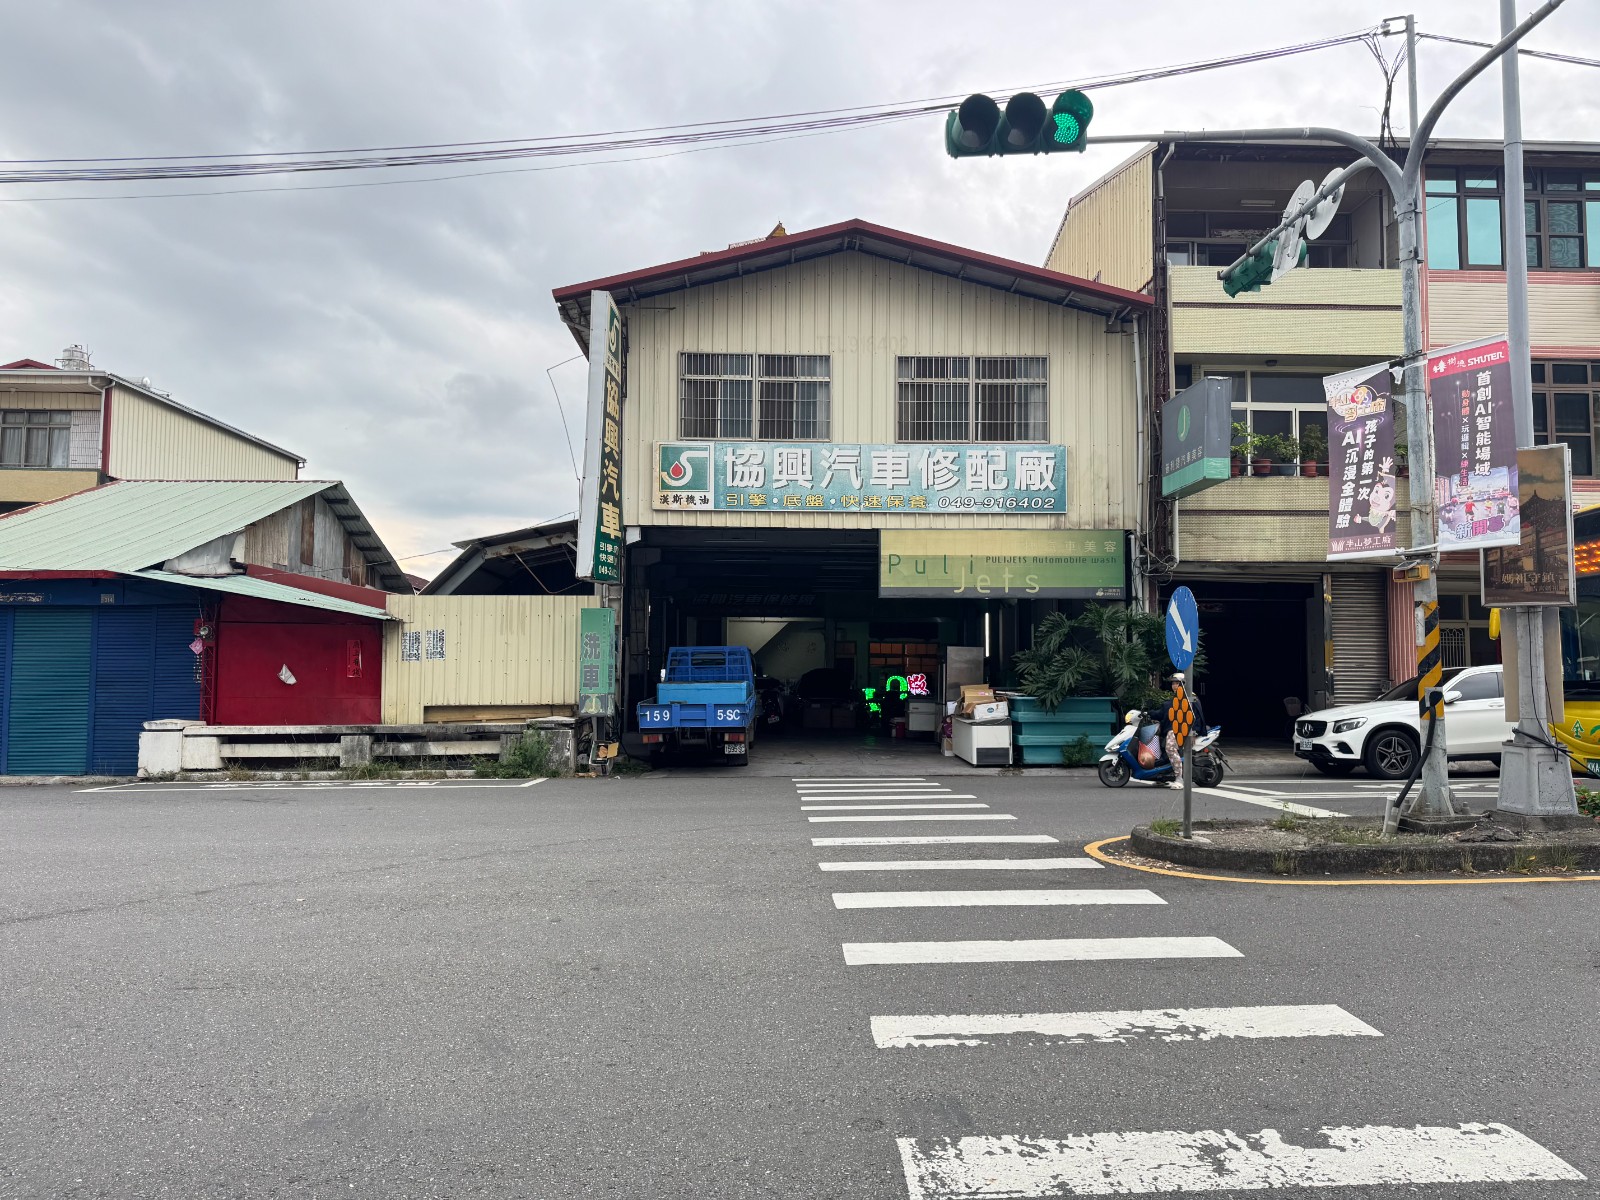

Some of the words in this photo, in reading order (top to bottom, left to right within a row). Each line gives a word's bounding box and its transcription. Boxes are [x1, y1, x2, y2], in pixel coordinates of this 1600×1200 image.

[1467, 351, 1504, 366] SHUTER
[1474, 371, 1493, 477] 首創AI智能場域
[599, 374, 621, 540] 協興汽車
[724, 447, 1057, 492] 協興汽車修配廠
[1357, 419, 1378, 501] 孩子的第一次
[937, 496, 1056, 509] 049-916402
[953, 566, 1040, 594] Jets
[582, 631, 601, 691] 洗車
[717, 709, 741, 721] 5-SC
